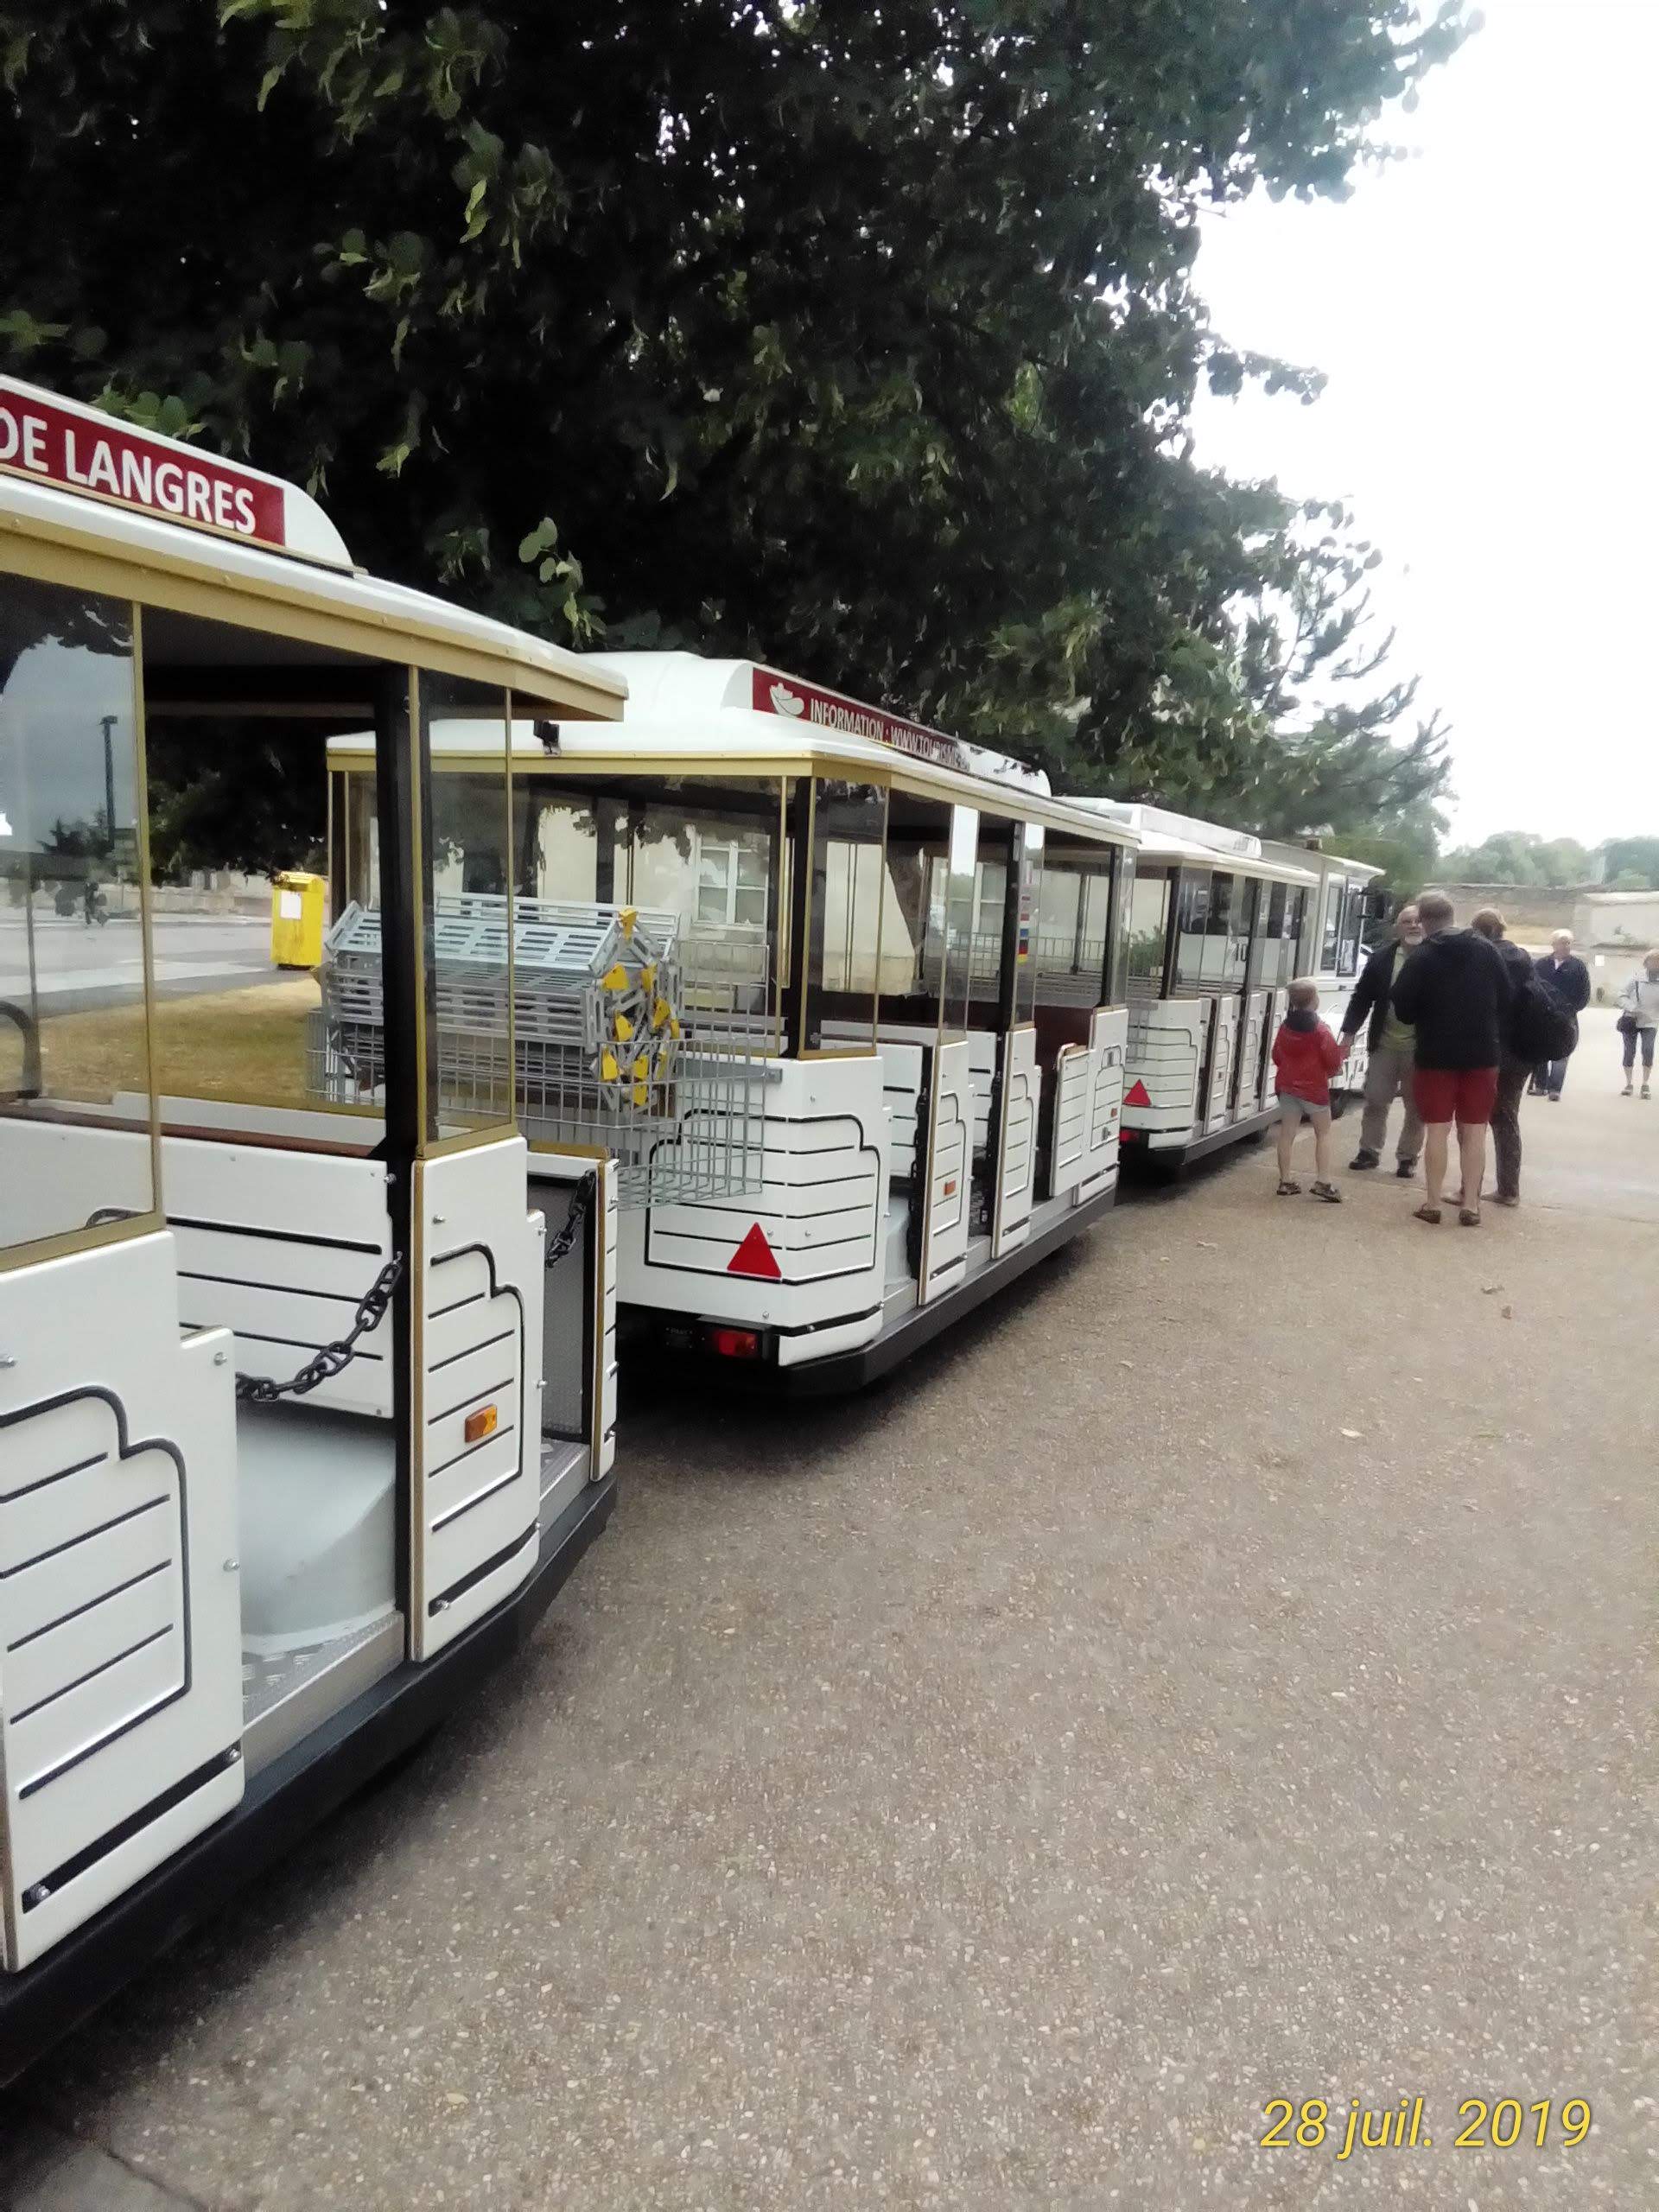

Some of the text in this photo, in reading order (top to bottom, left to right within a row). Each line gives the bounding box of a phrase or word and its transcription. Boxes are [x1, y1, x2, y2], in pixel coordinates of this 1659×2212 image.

[0, 407, 257, 535] DE LANGRES
[810, 697, 884, 741] INFORMATION
